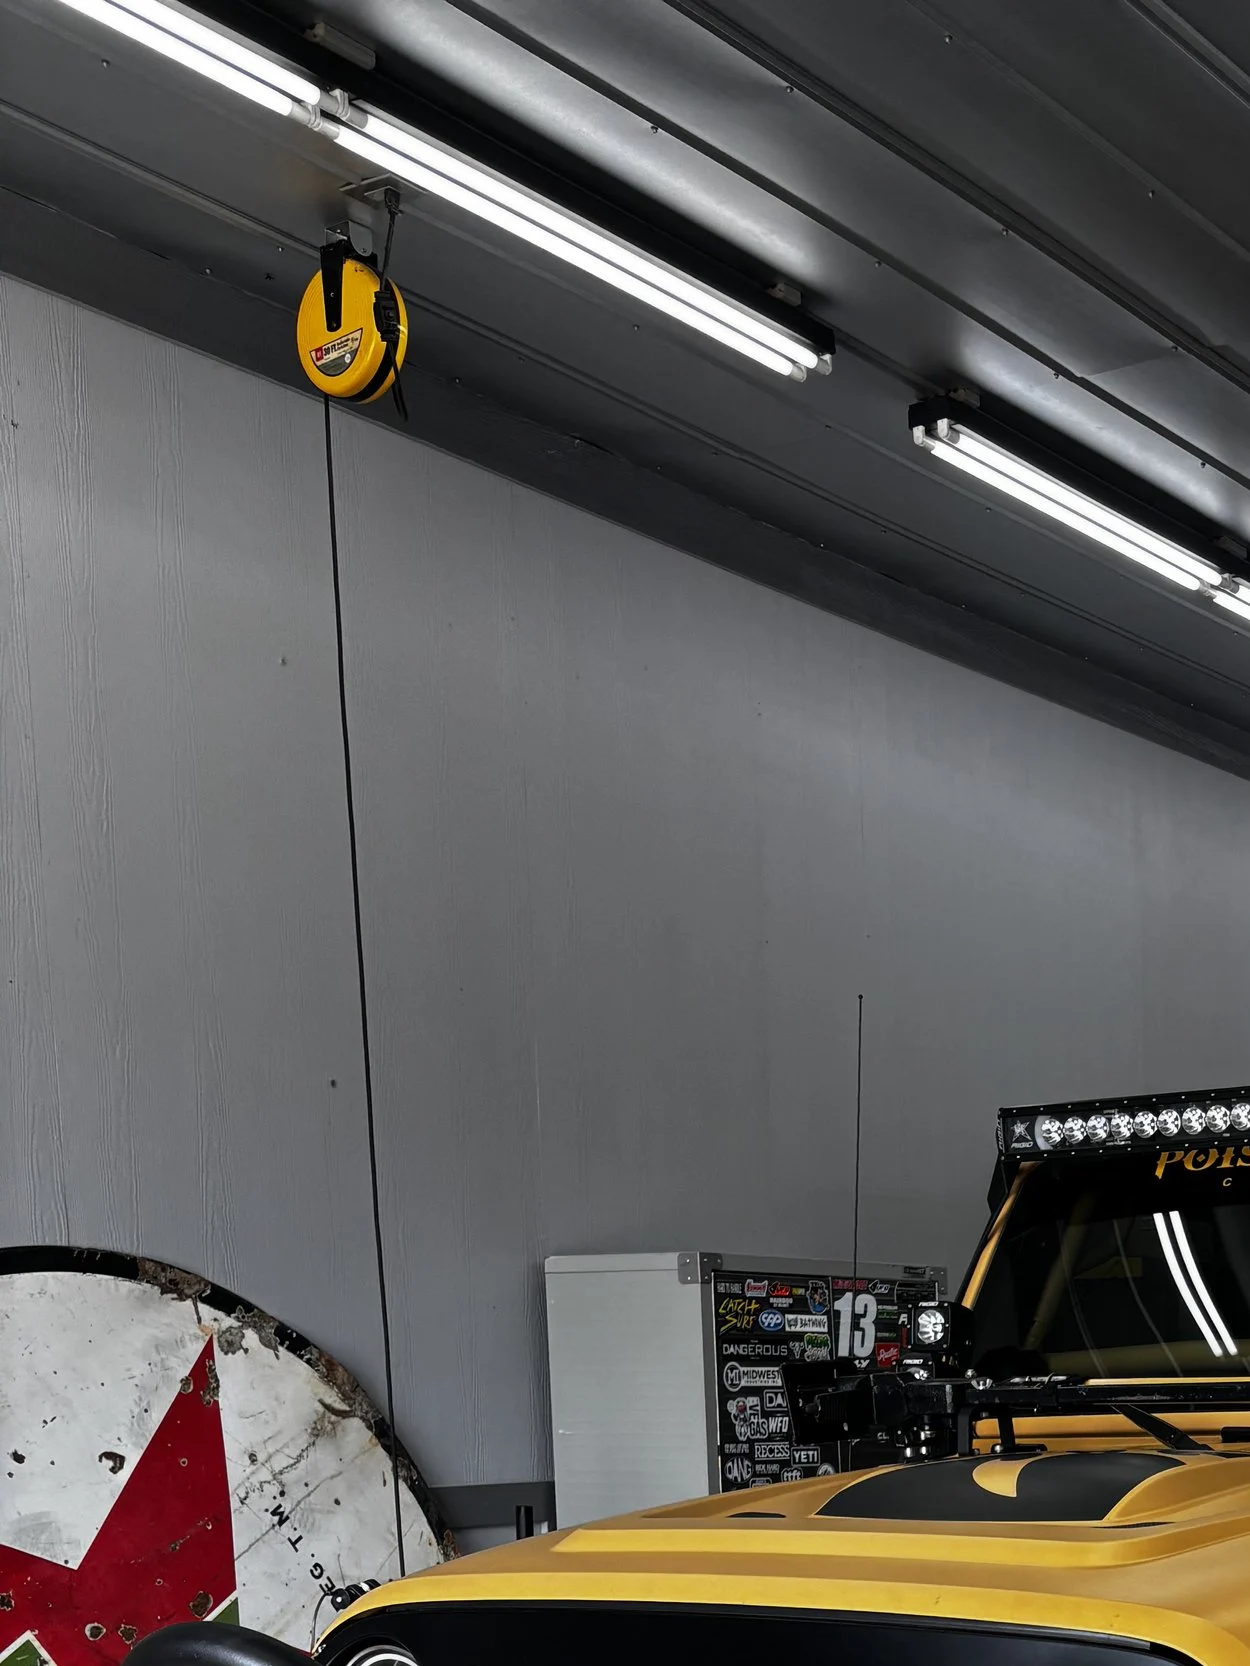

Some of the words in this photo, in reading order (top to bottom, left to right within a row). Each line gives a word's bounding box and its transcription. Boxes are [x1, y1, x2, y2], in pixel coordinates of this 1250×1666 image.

[719, 1297, 760, 1314] CATCH
[834, 1291, 879, 1358] 13
[722, 1343, 788, 1356] DANGEROUS
[742, 1370, 781, 1380] MIDWEST
[754, 1445, 790, 1458] RECESS
[793, 1450, 818, 1463] YETI
